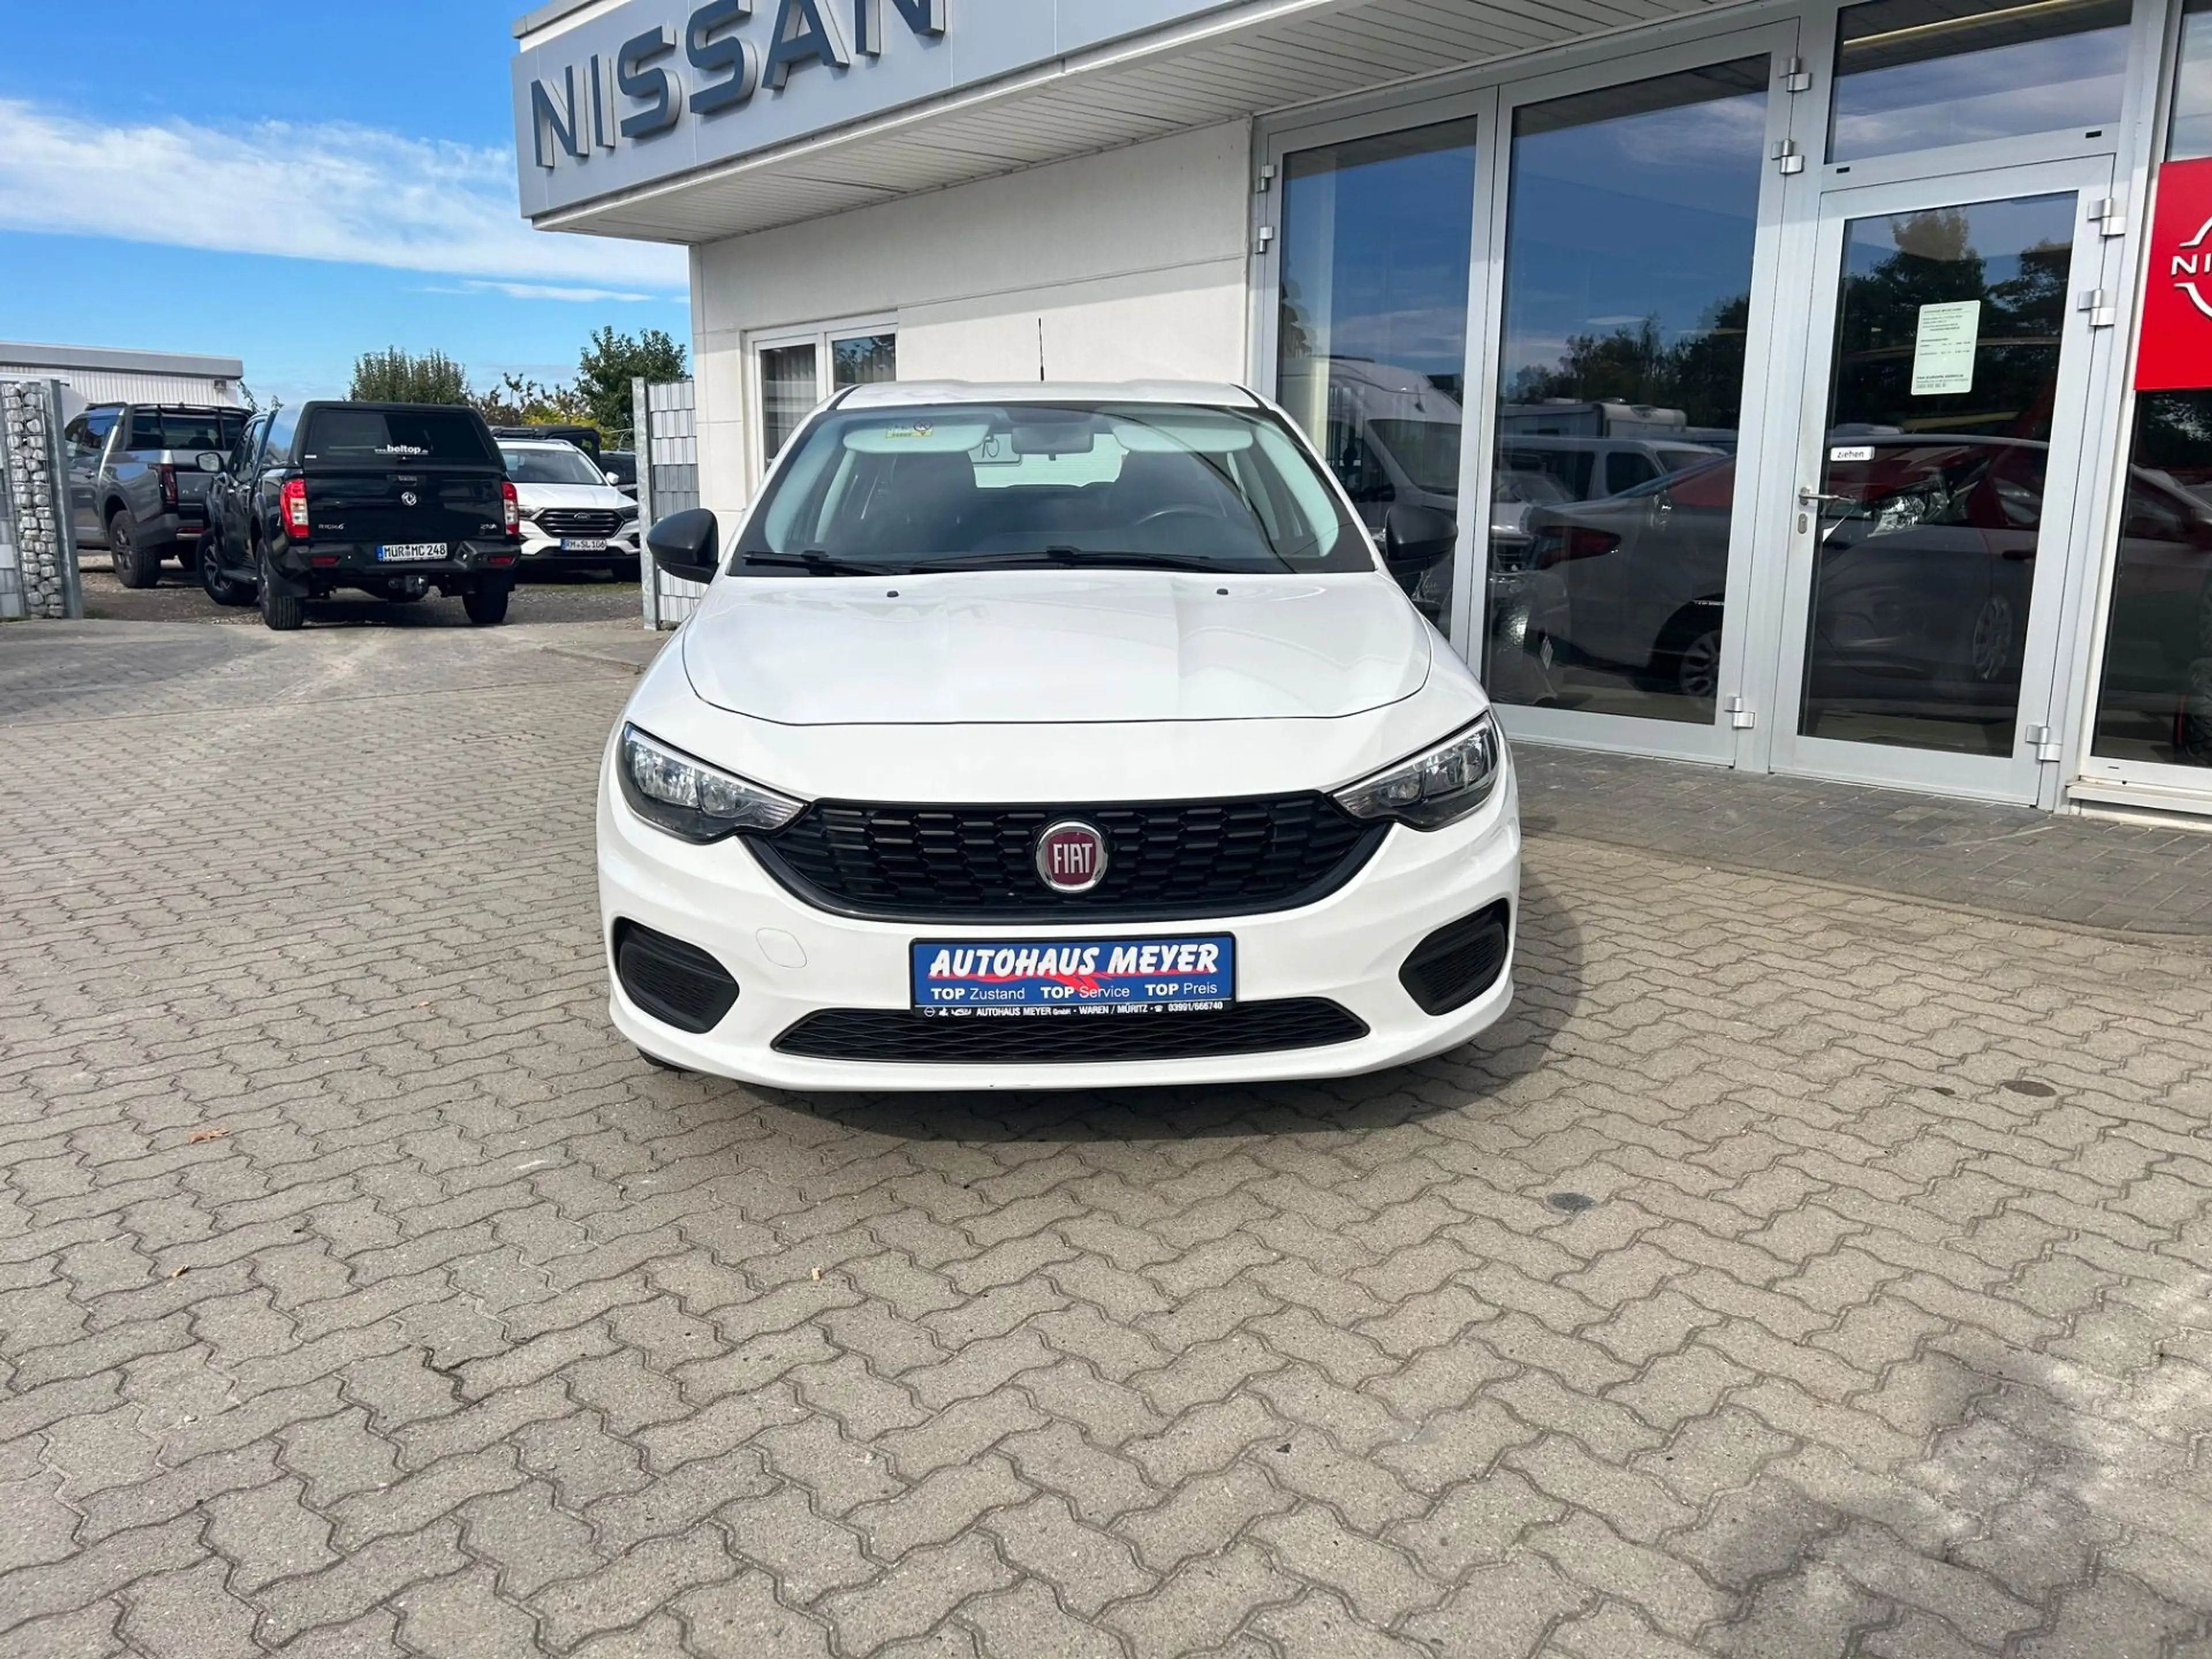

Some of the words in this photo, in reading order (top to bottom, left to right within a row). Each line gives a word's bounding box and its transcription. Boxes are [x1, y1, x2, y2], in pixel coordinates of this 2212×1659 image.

[1837, 450, 1864, 459] ziehen
[411, 544, 425, 556] MC
[427, 544, 446, 555] 248
[1053, 843, 1093, 874] FIAT
[929, 947, 1100, 978] AUTOHAUS
[1107, 943, 1219, 975] MEYER
[931, 987, 965, 1000] TOP
[969, 987, 1025, 1000] Zustand
[1040, 986, 1074, 999] TOP
[1079, 986, 1130, 998] Service
[1145, 983, 1179, 996] TOP
[1183, 982, 1218, 995] Preis
[976, 1007, 1021, 1016] AUTOHAUS
[1023, 1007, 1051, 1016] MEYER
[1079, 1005, 1109, 1014] WAREN
[1117, 1003, 1148, 1014] MÜRITZ
